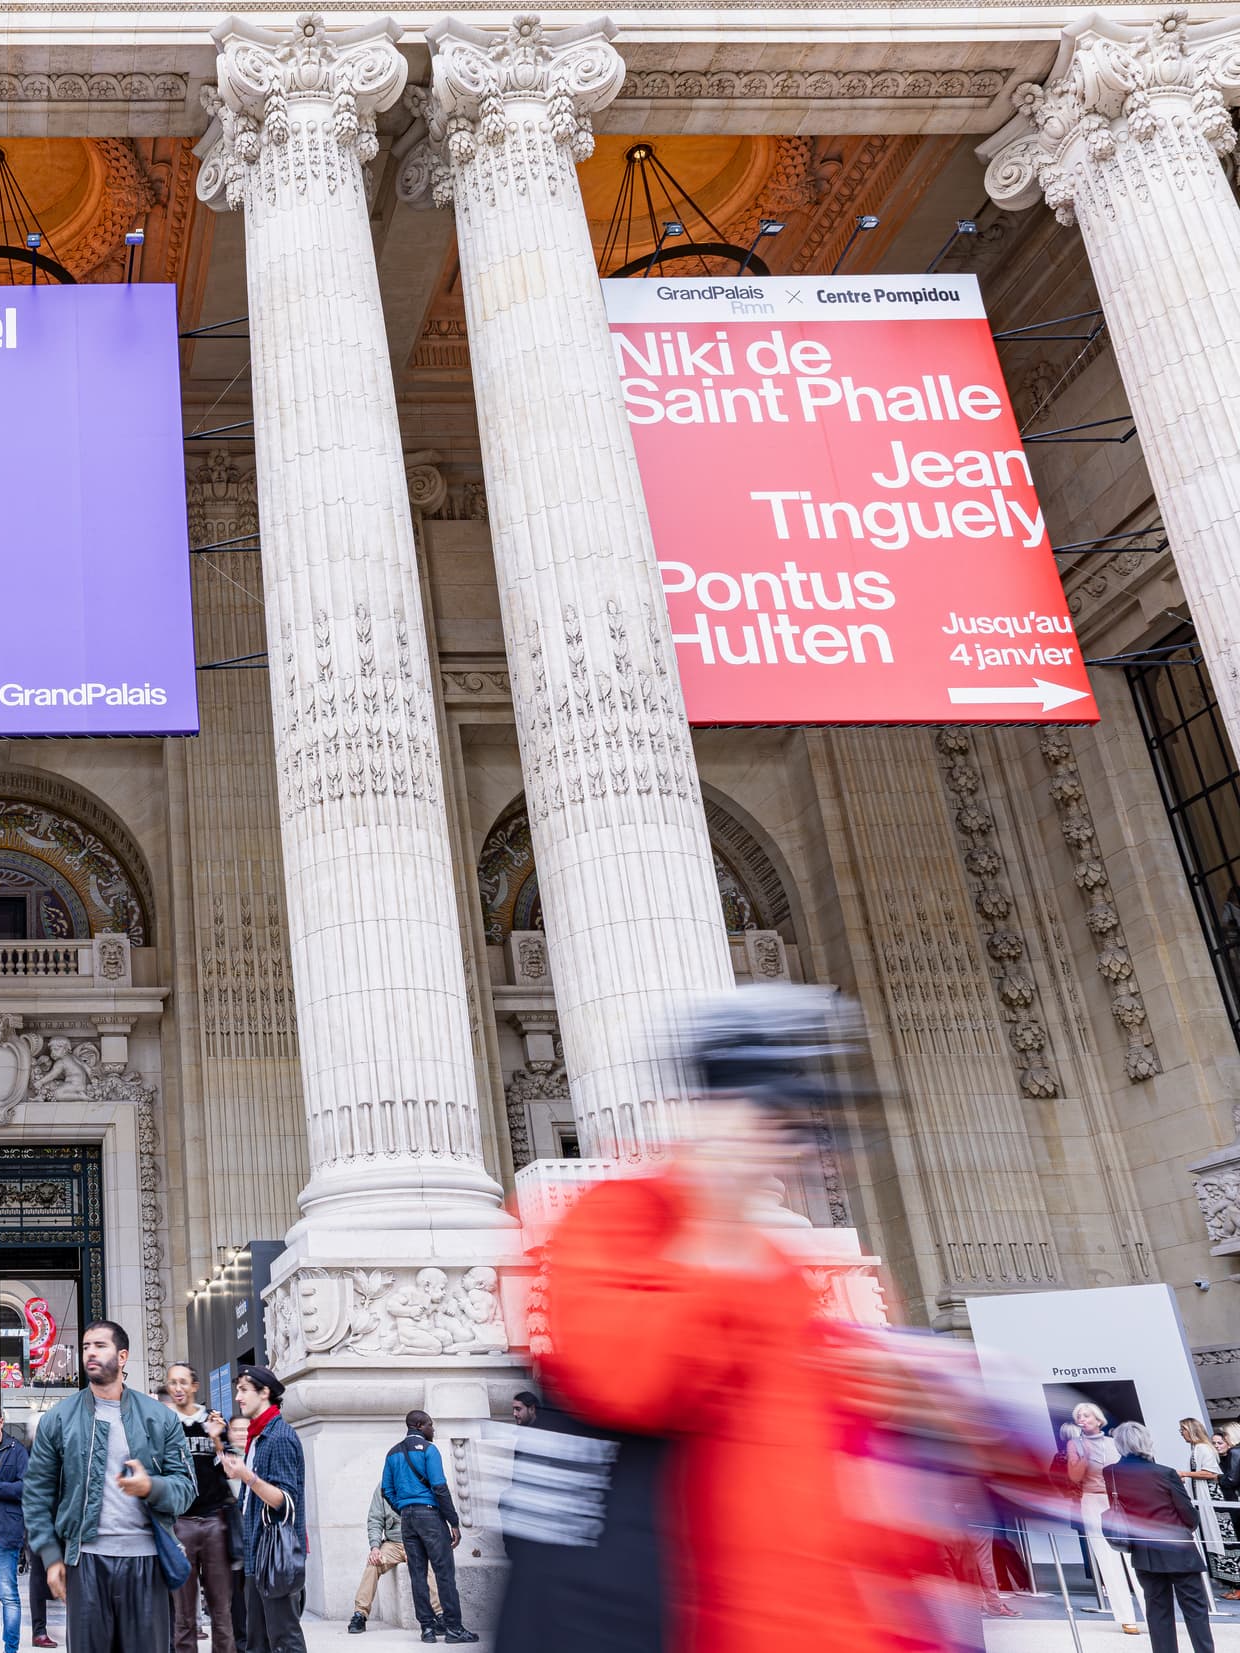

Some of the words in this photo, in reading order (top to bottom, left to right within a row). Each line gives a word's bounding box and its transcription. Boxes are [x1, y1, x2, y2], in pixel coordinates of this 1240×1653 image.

[656, 285, 765, 301] GrandPalais
[816, 289, 872, 304] Centre
[874, 287, 961, 305] Pompidou
[731, 301, 776, 315] Rmn
[609, 331, 735, 377] Niki
[746, 330, 832, 376] de
[620, 378, 790, 425] Saint
[795, 374, 1002, 423] Phalle
[871, 440, 1034, 488] Jean
[750, 489, 1045, 550] Tinguely
[657, 561, 896, 611] Pontus
[949, 643, 973, 666] 4
[974, 643, 1074, 671] janvier
[1052, 1366, 1117, 1378] Programme
